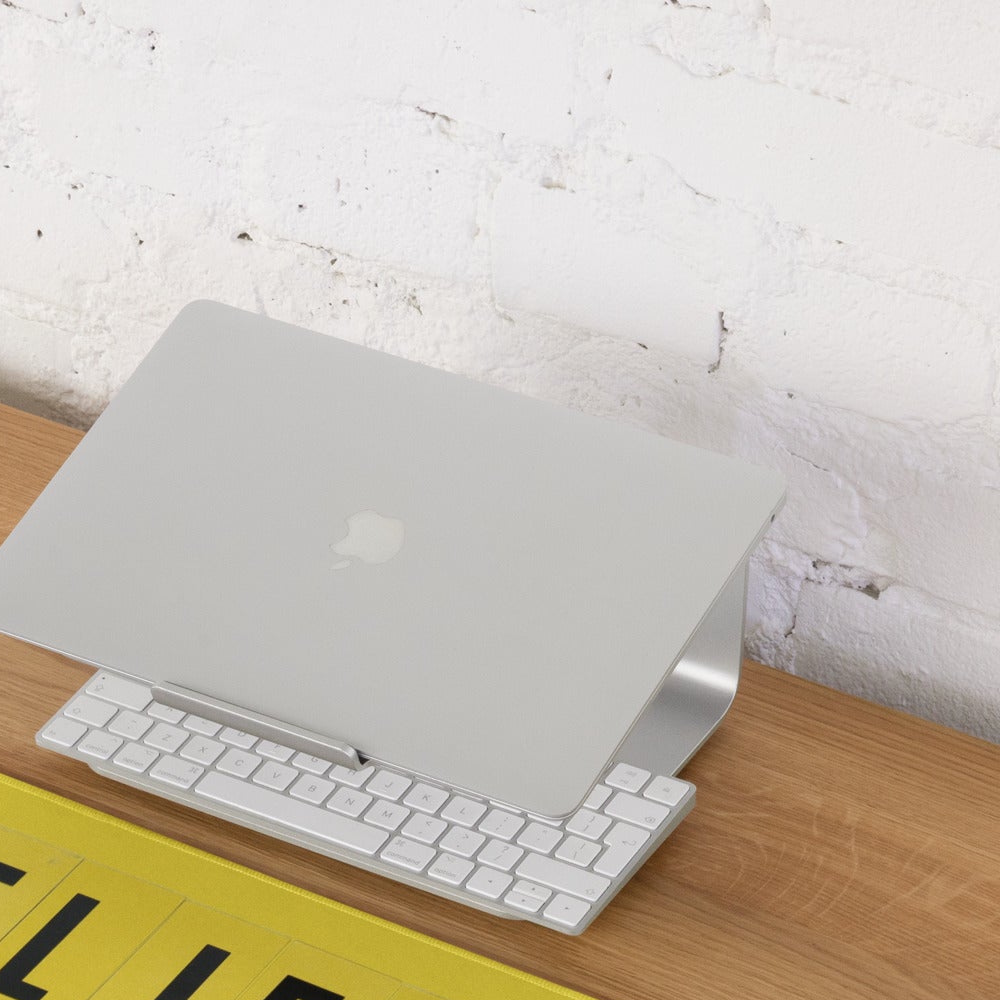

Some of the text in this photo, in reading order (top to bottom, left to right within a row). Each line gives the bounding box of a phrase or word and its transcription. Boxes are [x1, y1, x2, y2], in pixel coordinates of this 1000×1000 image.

[162, 733, 171, 741] Z
[234, 759, 244, 767] C
[272, 771, 281, 779] V
[307, 785, 317, 793] B
[381, 810, 393, 818] M
[459, 807, 467, 815] L
[386, 851, 420, 865] command
